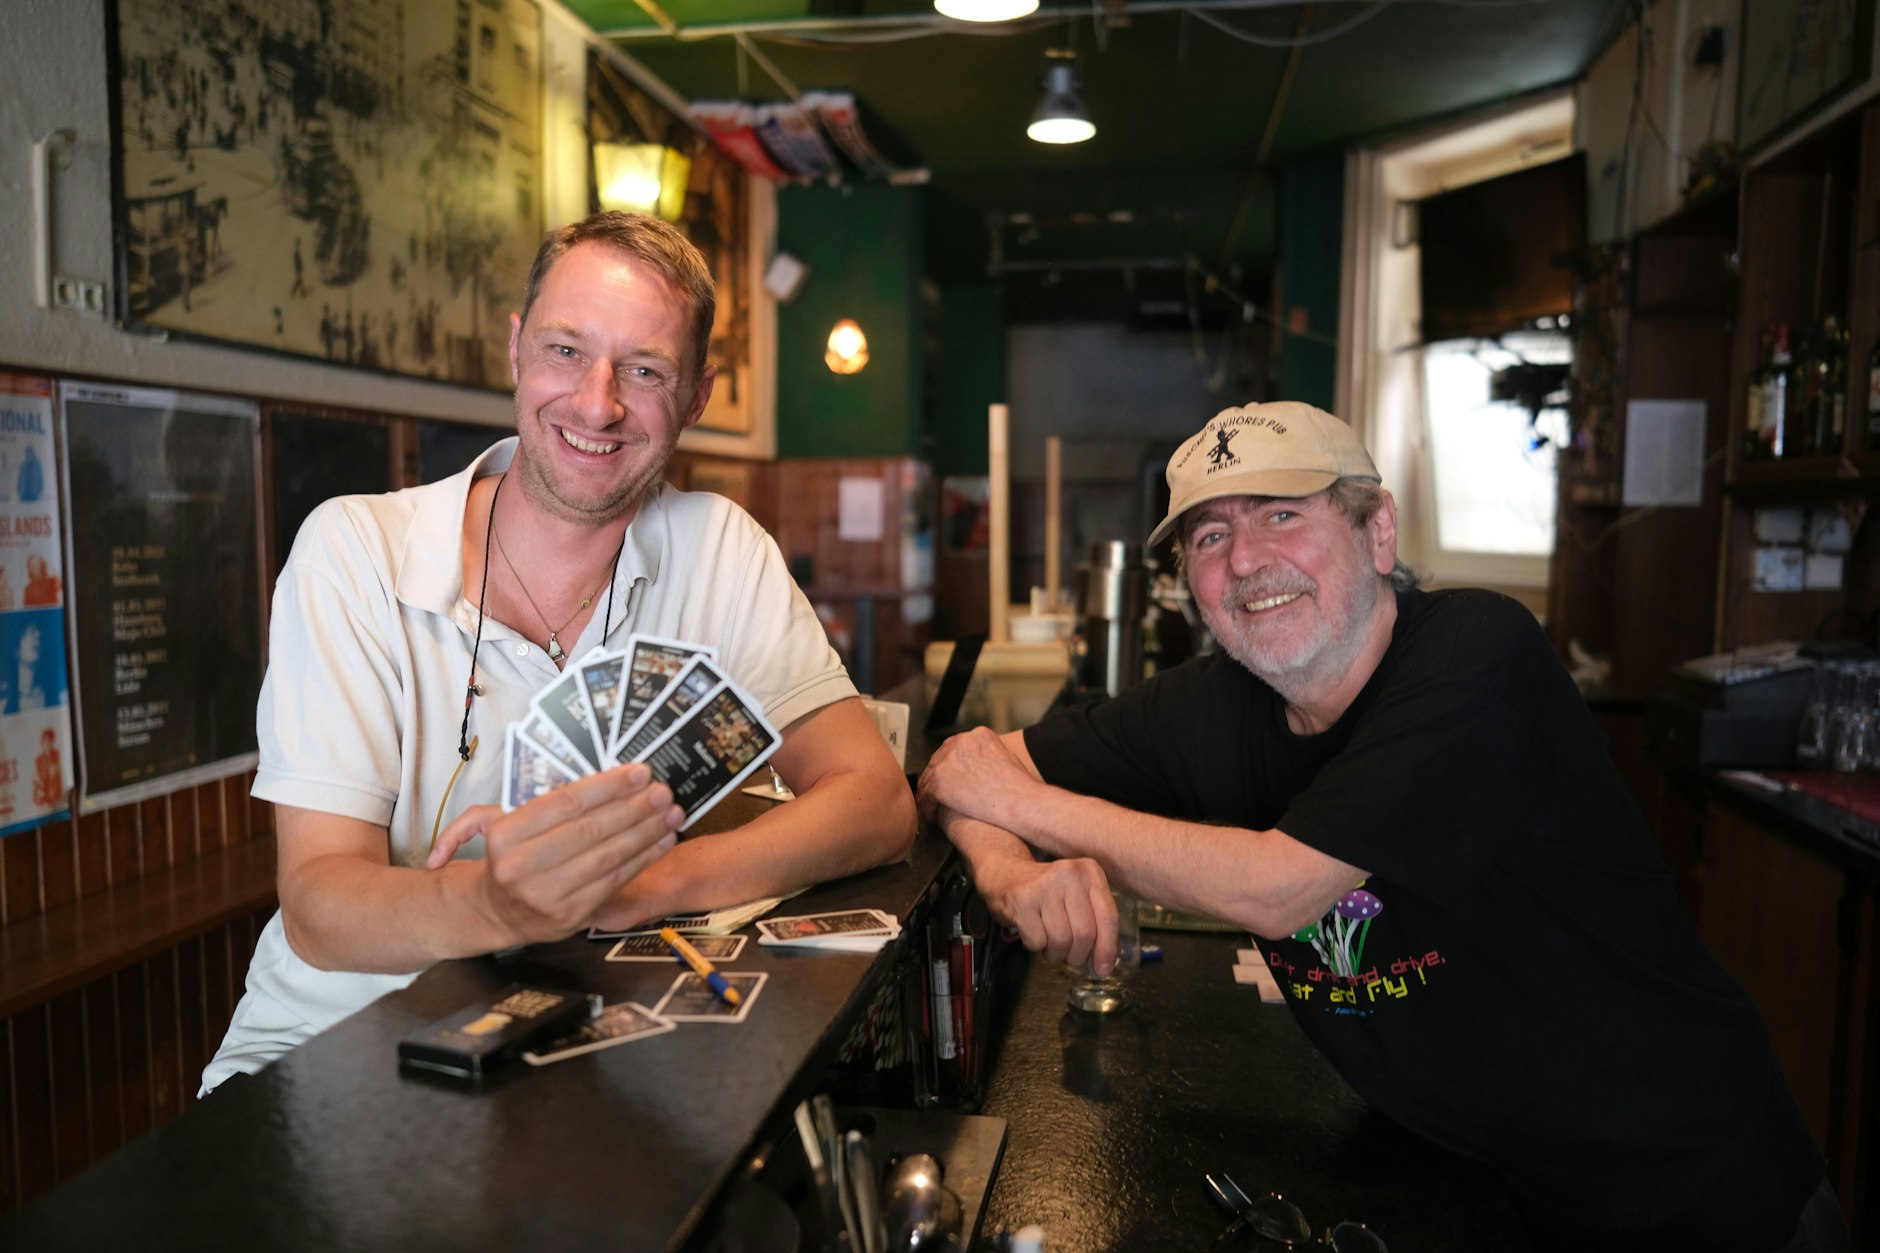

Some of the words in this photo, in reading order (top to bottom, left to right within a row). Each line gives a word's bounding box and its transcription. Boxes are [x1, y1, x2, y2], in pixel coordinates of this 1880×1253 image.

[1219, 416, 1266, 431] WHORES
[1266, 419, 1287, 435] PUB
[1207, 457, 1241, 475] BERLIN
[1390, 950, 1446, 975] drive,
[1291, 981, 1314, 1001] at
[1329, 985, 1356, 1005] and
[1366, 975, 1408, 1003] Fly
